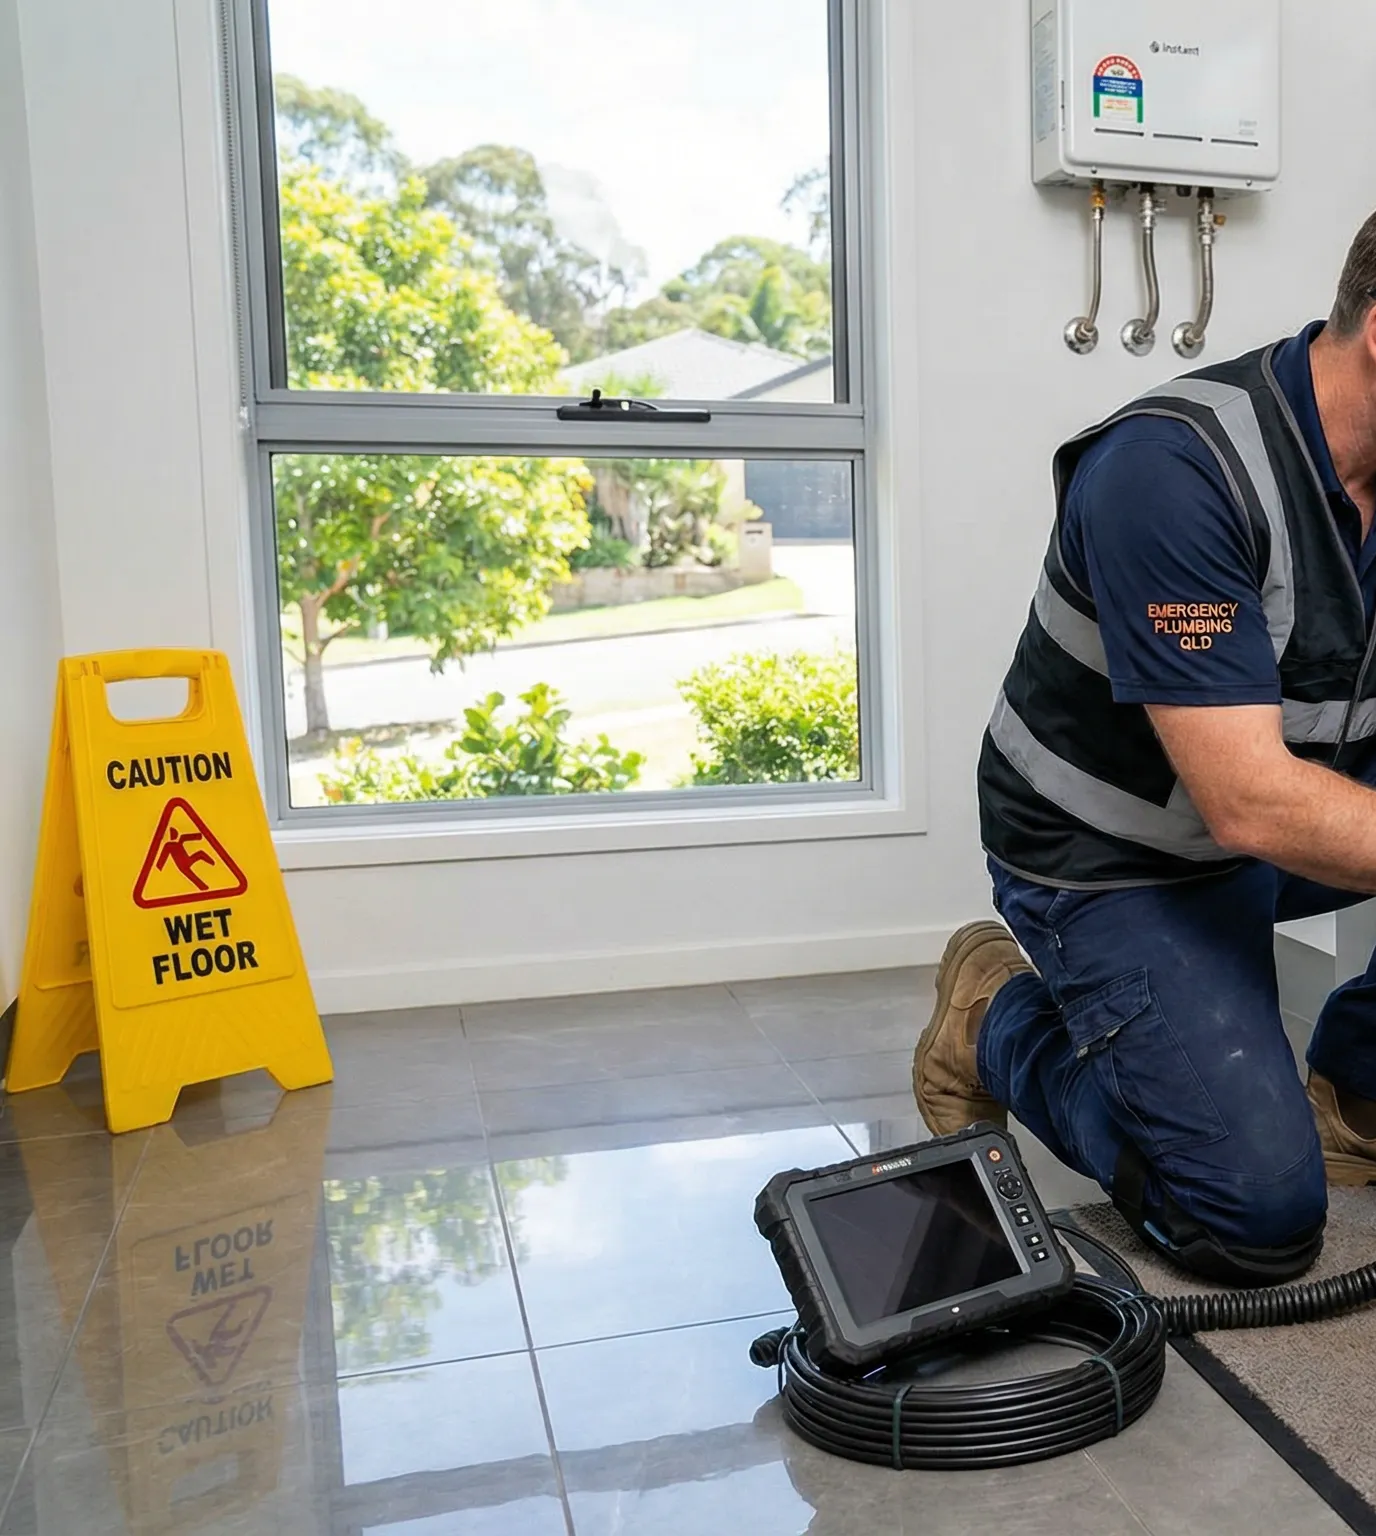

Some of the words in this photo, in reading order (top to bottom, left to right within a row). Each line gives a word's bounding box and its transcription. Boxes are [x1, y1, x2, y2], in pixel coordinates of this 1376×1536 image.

[1147, 602, 1239, 618] EMERGENCY
[1154, 618, 1233, 634] PLUMBING
[1179, 635, 1212, 651] QLD
[107, 752, 232, 790] CAUTION
[163, 908, 232, 946] WET
[152, 940, 259, 985] FLOOR
